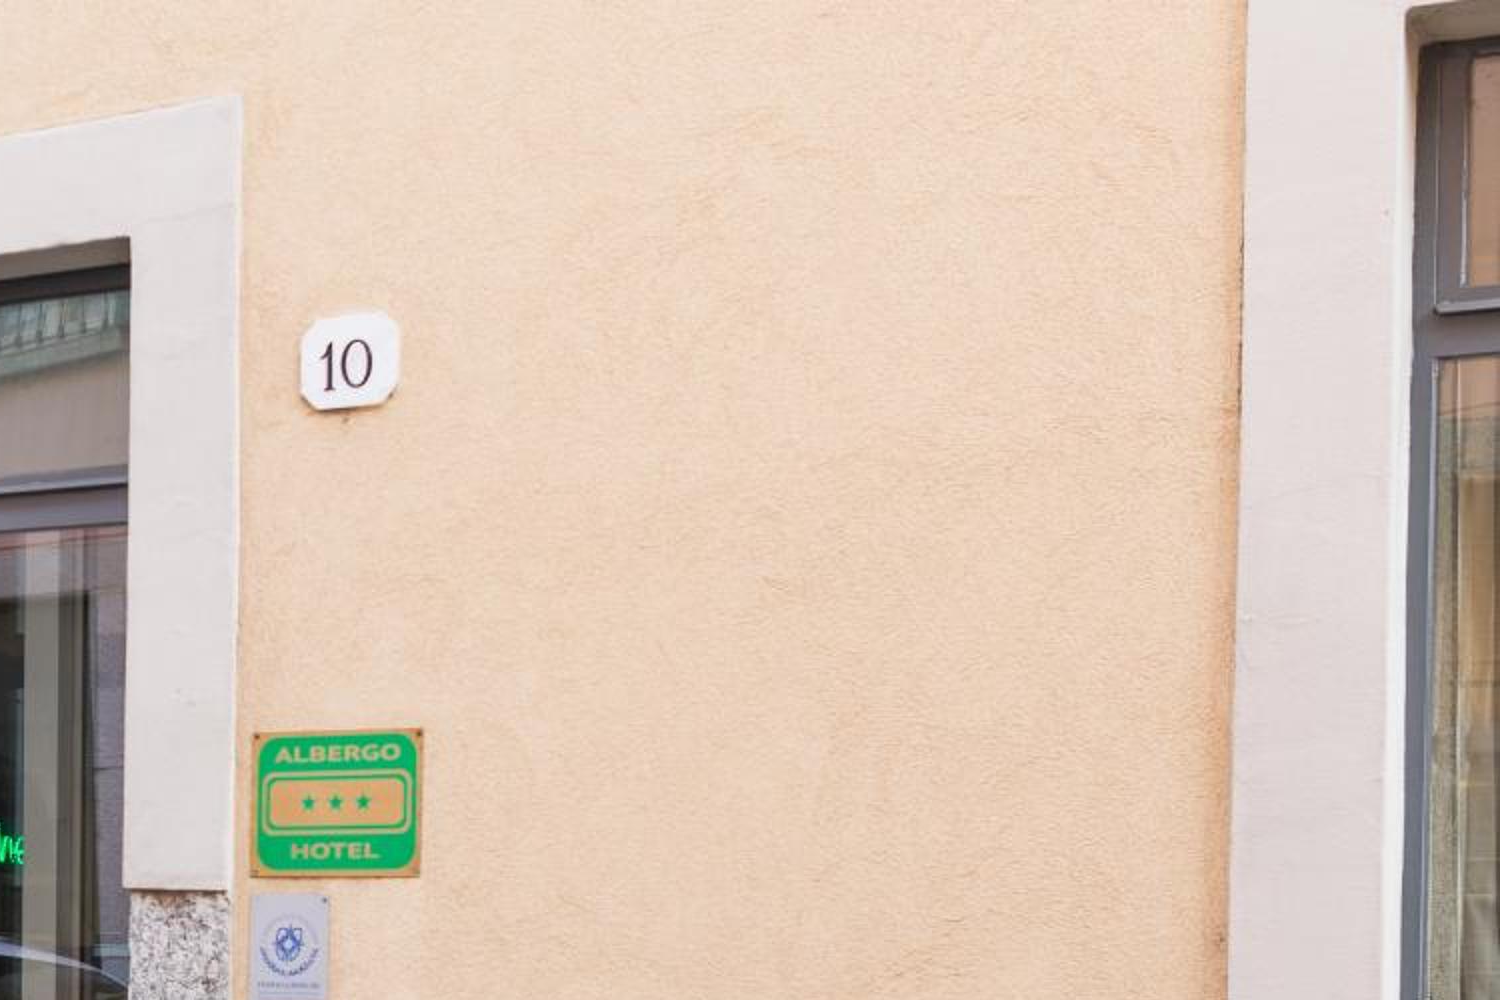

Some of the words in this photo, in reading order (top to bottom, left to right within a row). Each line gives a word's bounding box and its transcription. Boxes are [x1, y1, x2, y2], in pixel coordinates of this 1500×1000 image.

[318, 338, 373, 392] 10
[275, 743, 402, 764] ALBERGO
[290, 842, 381, 861] HOTEL
